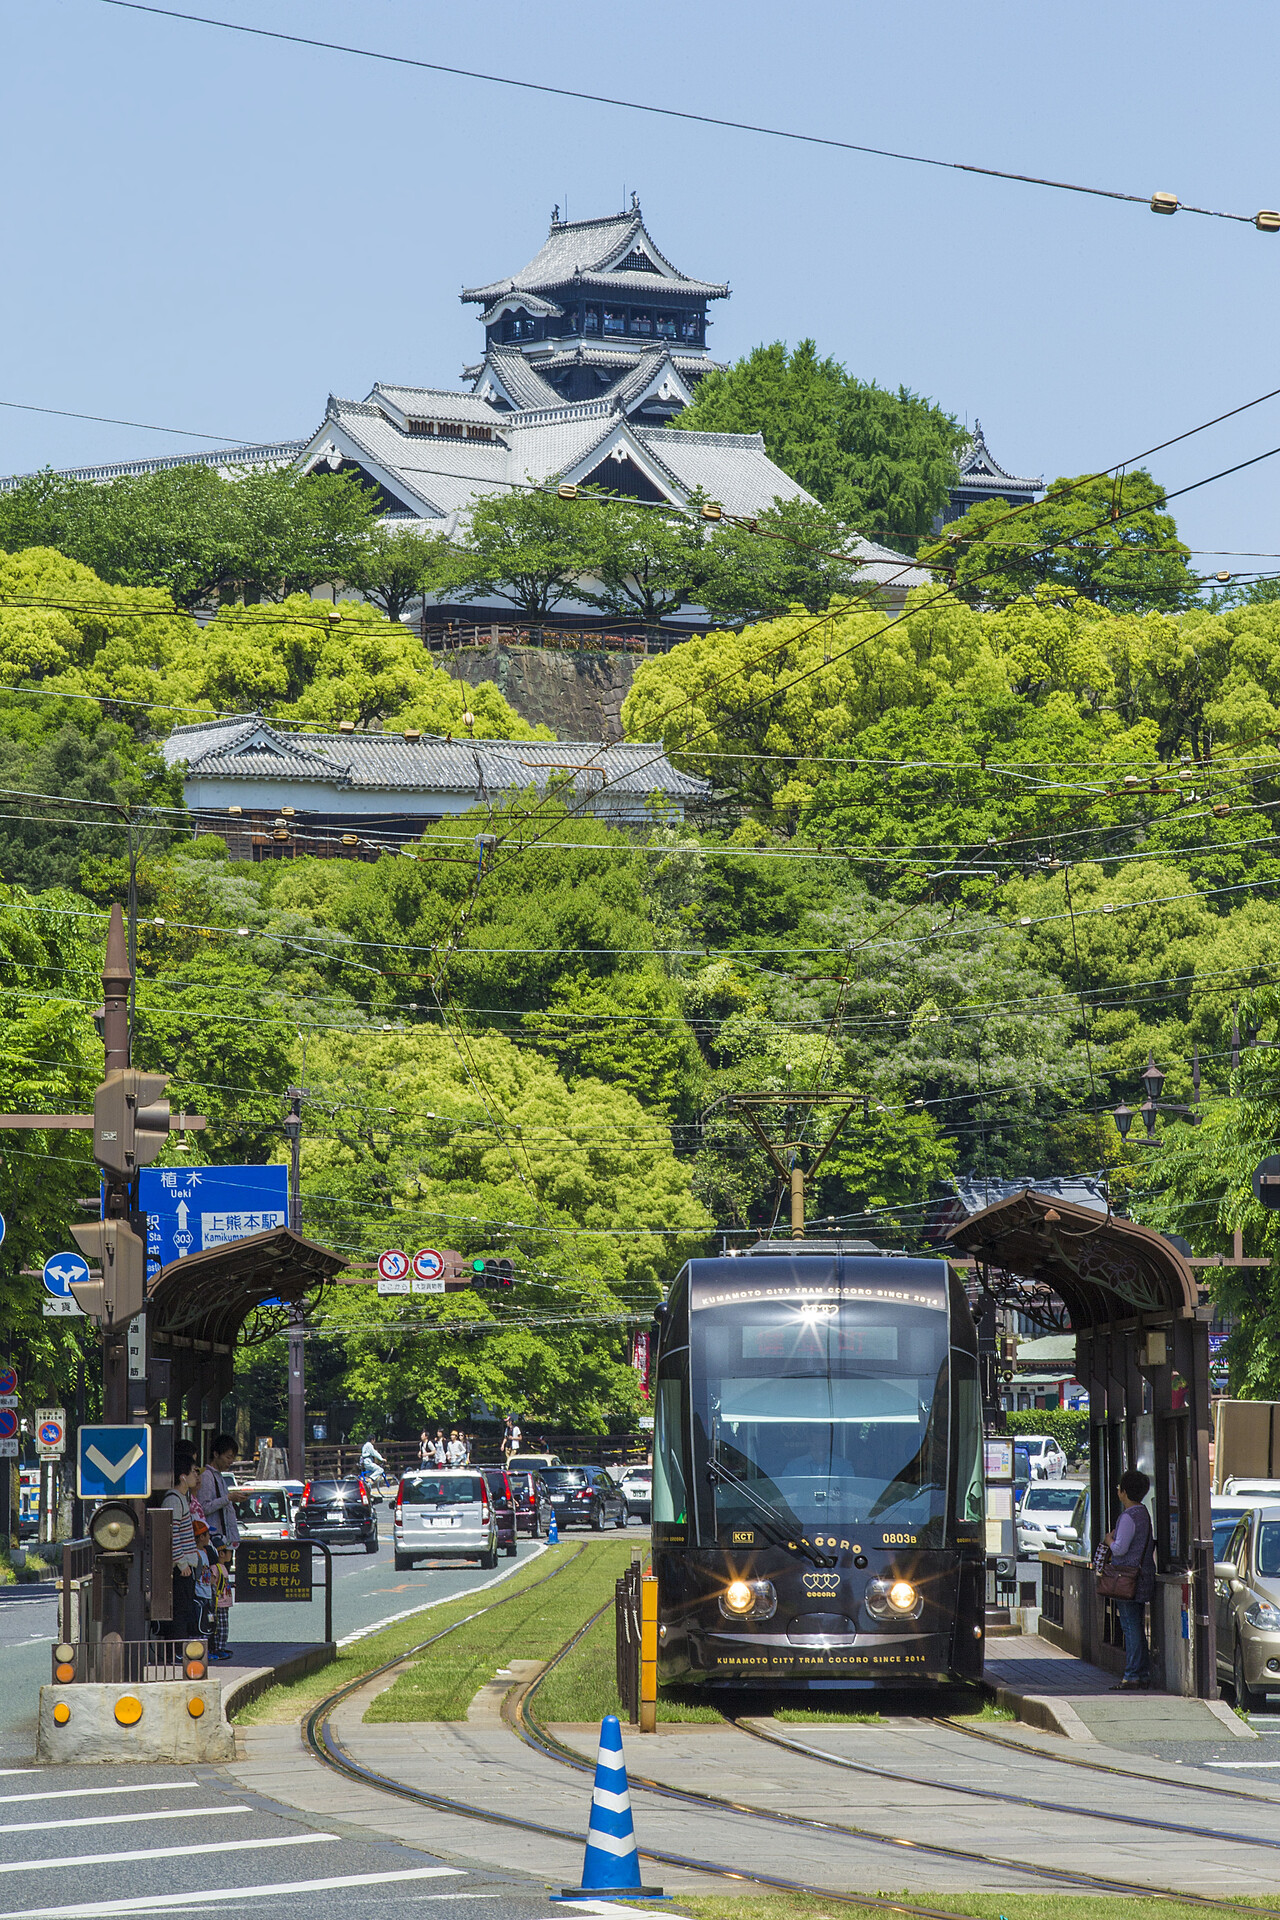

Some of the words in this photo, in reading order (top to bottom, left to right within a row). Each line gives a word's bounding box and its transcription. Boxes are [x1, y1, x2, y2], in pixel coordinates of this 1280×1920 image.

[161, 1171, 202, 1188] 植木
[171, 1189, 191, 1198] Ueki
[209, 1213, 277, 1231] 上熊本駅
[175, 1234, 191, 1244] 303
[701, 1290, 761, 1305] KUMAMOTO
[827, 1287, 872, 1295] COCORO
[877, 1290, 910, 1299] SINCE
[913, 1295, 938, 1305] 2014
[735, 1533, 752, 1541] KCT
[248, 1550, 300, 1560] ここからの
[248, 1563, 300, 1574] 道路横断は
[248, 1576, 301, 1586] できません
